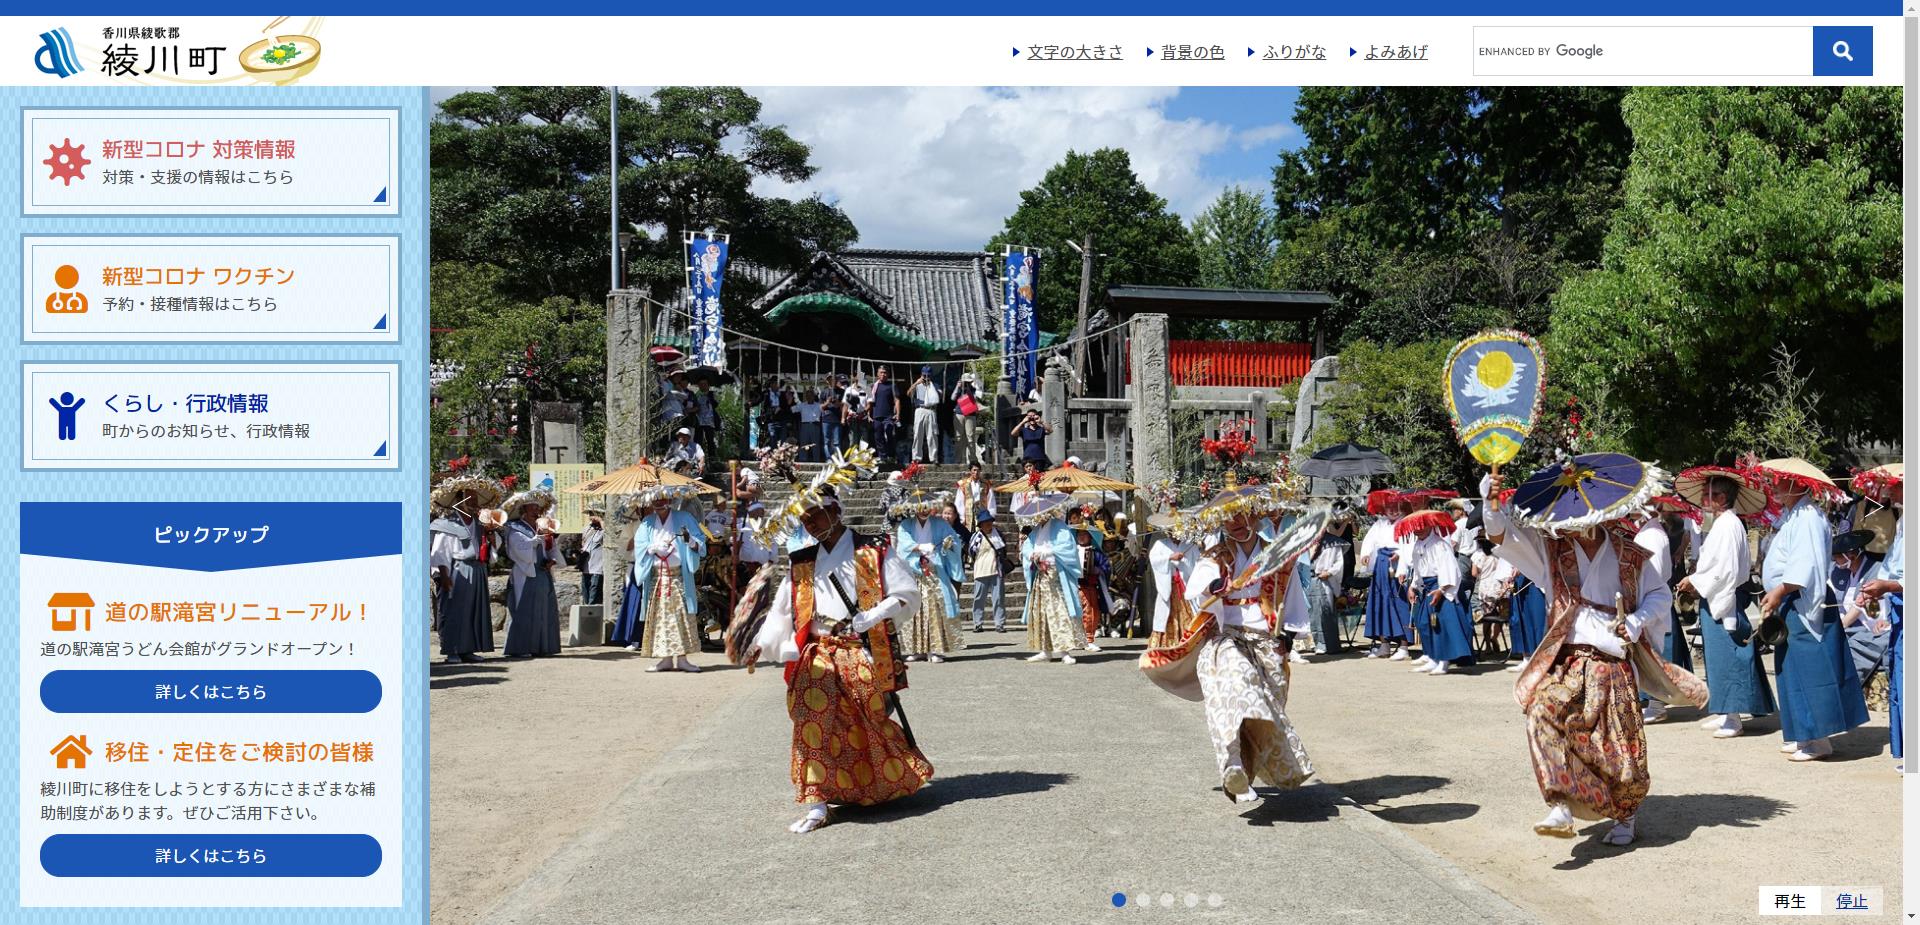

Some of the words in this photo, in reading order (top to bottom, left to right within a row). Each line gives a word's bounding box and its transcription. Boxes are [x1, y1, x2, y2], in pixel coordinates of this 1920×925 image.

[102, 26, 180, 40] 香川県綾歌郡
[1027, 43, 1122, 58] 文字の大きさ
[1161, 43, 1225, 58] 背景の色
[1262, 44, 1327, 58] ふりがな
[1365, 44, 1429, 58] よみあげ
[1479, 47, 1528, 56] ENHANCED
[1531, 47, 1551, 56] BY
[1555, 43, 1604, 60] Google
[100, 42, 227, 77] 綾川町
[102, 139, 205, 160] 新型コロナ
[212, 139, 295, 160] 対策情報
[102, 168, 293, 185] 対策・支援の情報はこちら
[102, 266, 206, 287] 新型コロナ
[214, 267, 295, 286] ワクチン
[102, 295, 277, 312] 予約・接種情報はこちら
[104, 392, 269, 414] くらし・行政情報
[102, 423, 310, 439] 町からのお知らせ、行政情報
[155, 524, 270, 544] ピックアップ
[105, 600, 365, 623] 道の駅滝宮リニューアル！
[40, 640, 353, 657] 道の駅滝宮うどん会館がグランドオープン！
[154, 684, 266, 700] 詳しくはこちら
[105, 741, 374, 763] 移住・定住をご検討の皆様
[40, 780, 376, 798] 綾川町に移住をしようとする方にさまざまな補
[40, 804, 317, 822] 助制度があります。ぜひご活用下さい。
[154, 847, 266, 864] 詳しくはこちら
[1773, 893, 1807, 909] 再生
[1835, 893, 1869, 910] 停止
